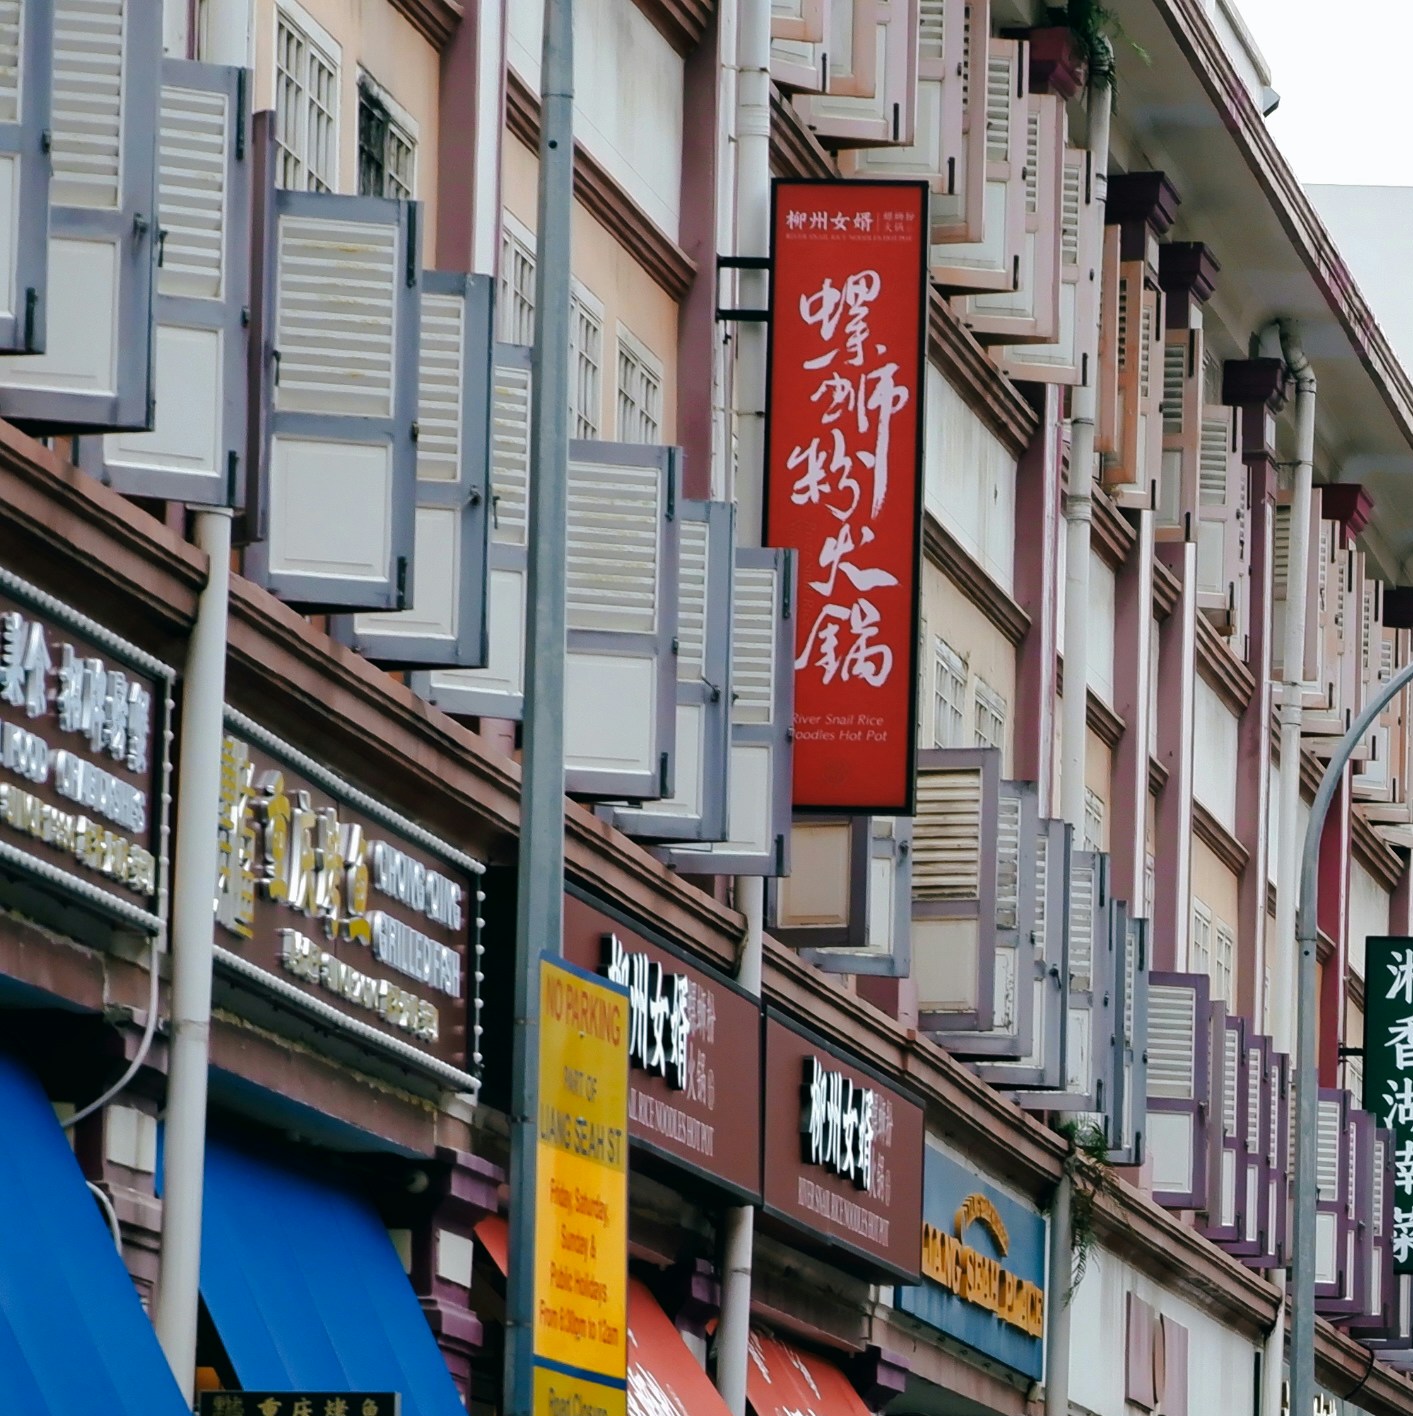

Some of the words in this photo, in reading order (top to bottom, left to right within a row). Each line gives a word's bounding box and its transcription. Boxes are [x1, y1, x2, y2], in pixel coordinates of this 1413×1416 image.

[786, 209, 873, 231] 柳州女婿
[825, 713, 853, 726] Snail
[857, 713, 884, 726] Rice
[839, 729, 862, 741] Hot
[866, 729, 887, 742] Pot
[545, 976, 564, 1022] NO
[565, 983, 621, 1047] PARKING
[540, 1103, 571, 1150] LIANG
[573, 1117, 605, 1160] SEAH
[606, 1127, 622, 1164] ST
